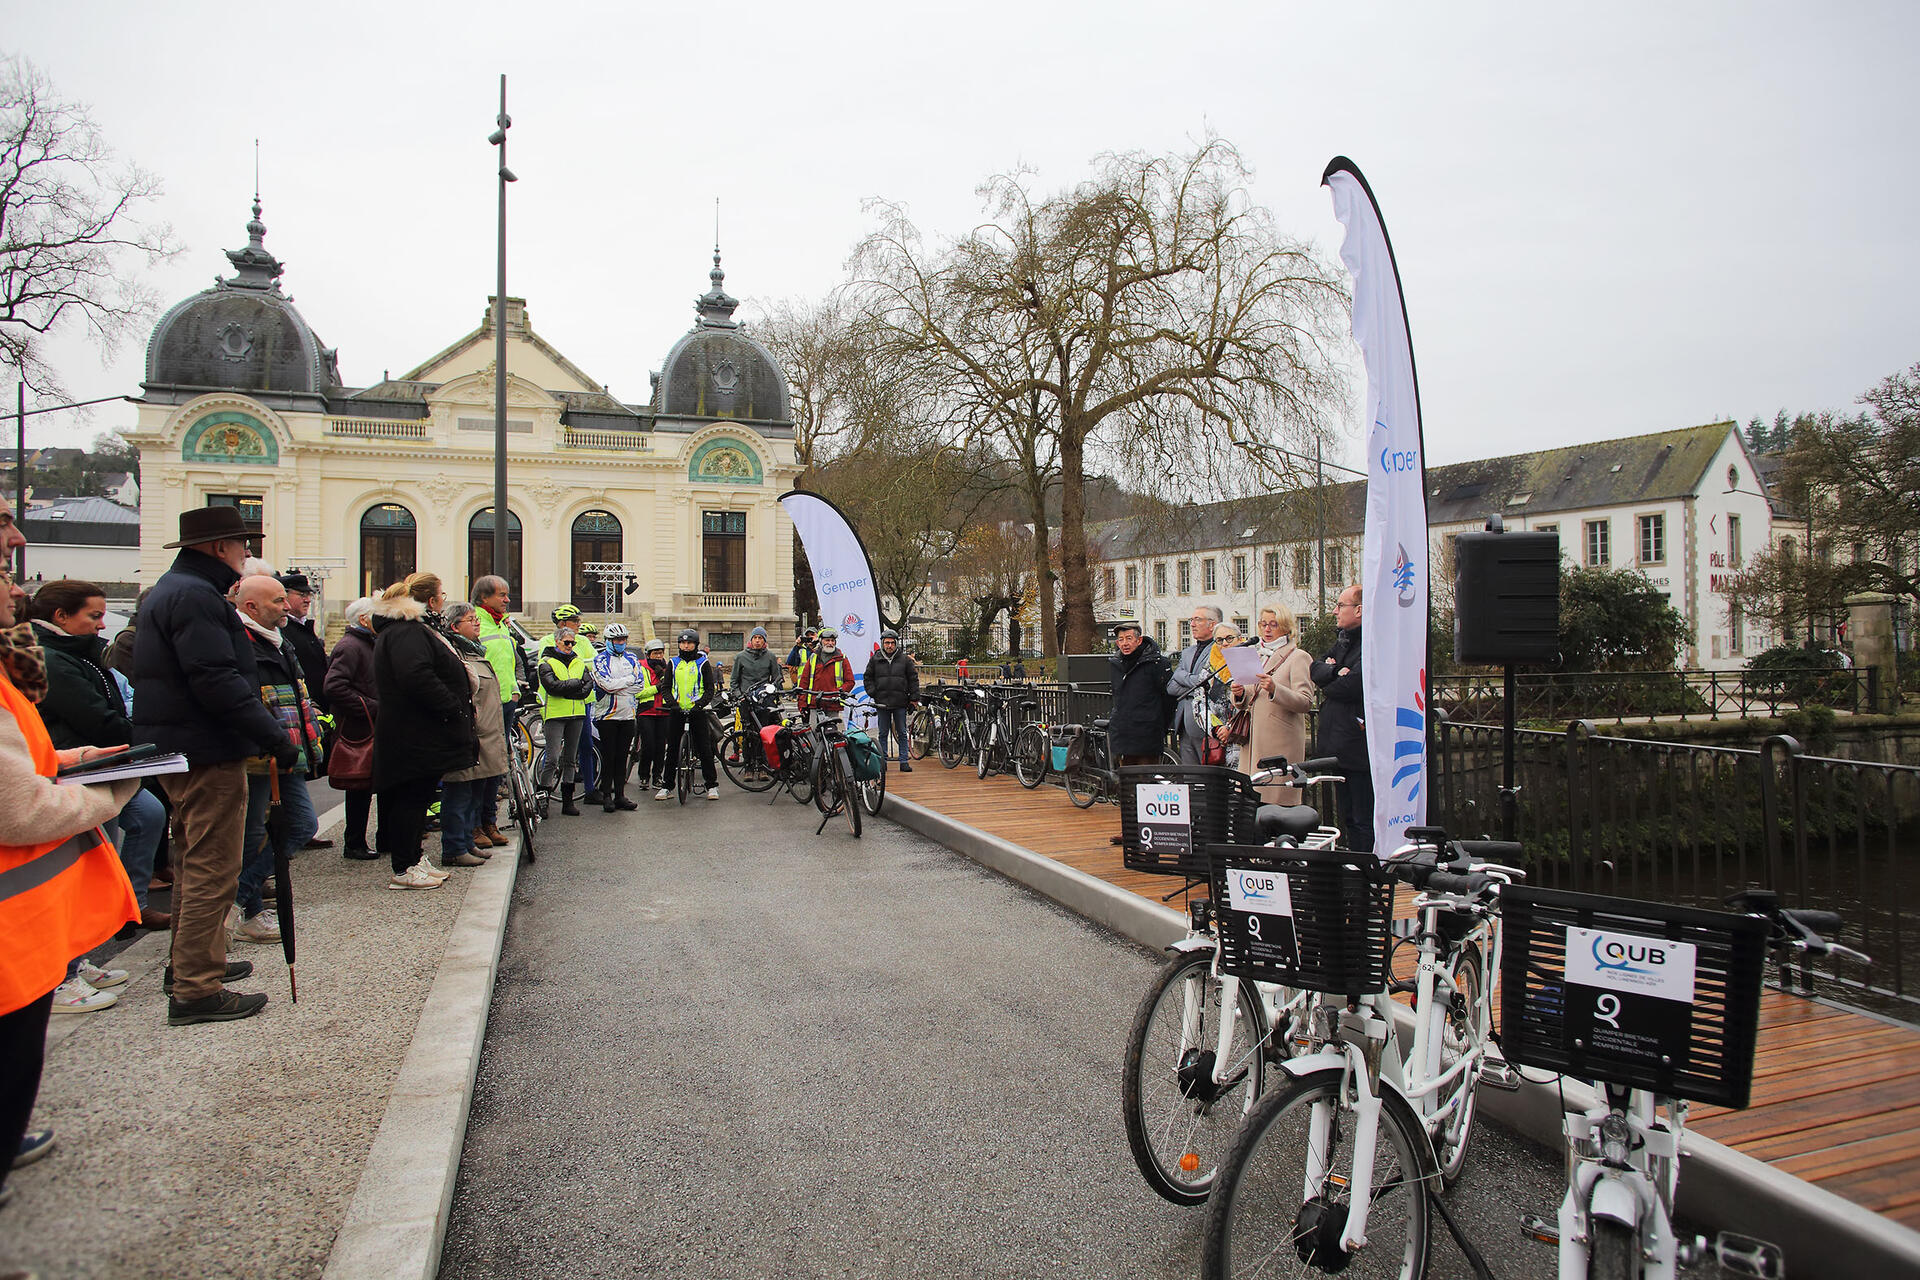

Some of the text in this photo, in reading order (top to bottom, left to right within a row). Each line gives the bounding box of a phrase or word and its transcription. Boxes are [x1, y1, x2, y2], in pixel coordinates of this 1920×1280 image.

[1710, 550, 1725, 567] PÔLE
[822, 577, 867, 595] Gemper
[1157, 791, 1179, 801] vélo
[1146, 803, 1180, 816] QUB
[1246, 878, 1274, 890] QUB
[1606, 942, 1665, 965] QUB
